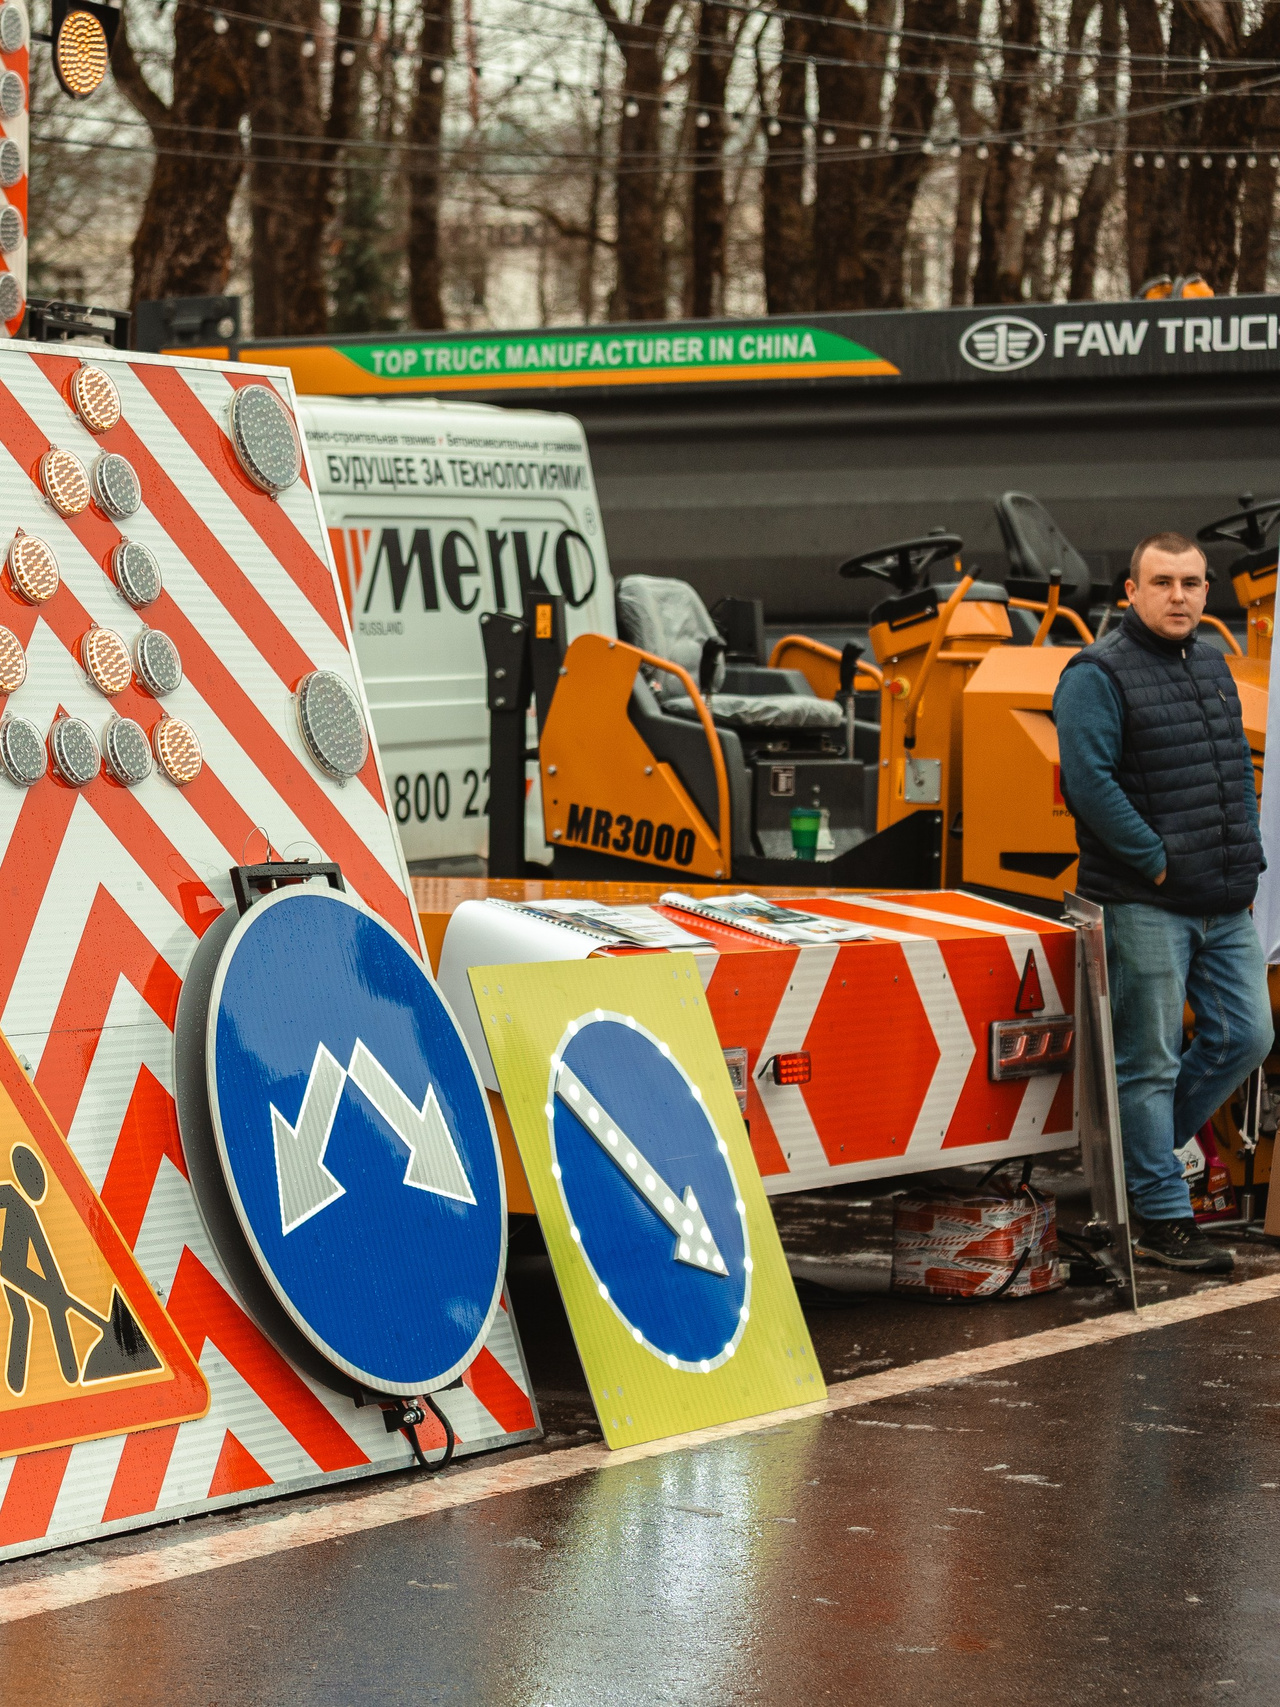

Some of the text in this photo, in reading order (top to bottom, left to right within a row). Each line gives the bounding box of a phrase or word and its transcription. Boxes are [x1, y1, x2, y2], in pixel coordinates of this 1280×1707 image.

[371, 332, 817, 375] TOP TRUCK MANUFACTURER IN CHINA
[1053, 319, 1149, 358] FAW
[326, 455, 419, 491] БУДУЩЕЕ
[421, 458, 447, 486] ЗА
[359, 621, 404, 636] RUSSLAND
[395, 772, 450, 824] 800
[566, 804, 696, 867] MR3000
